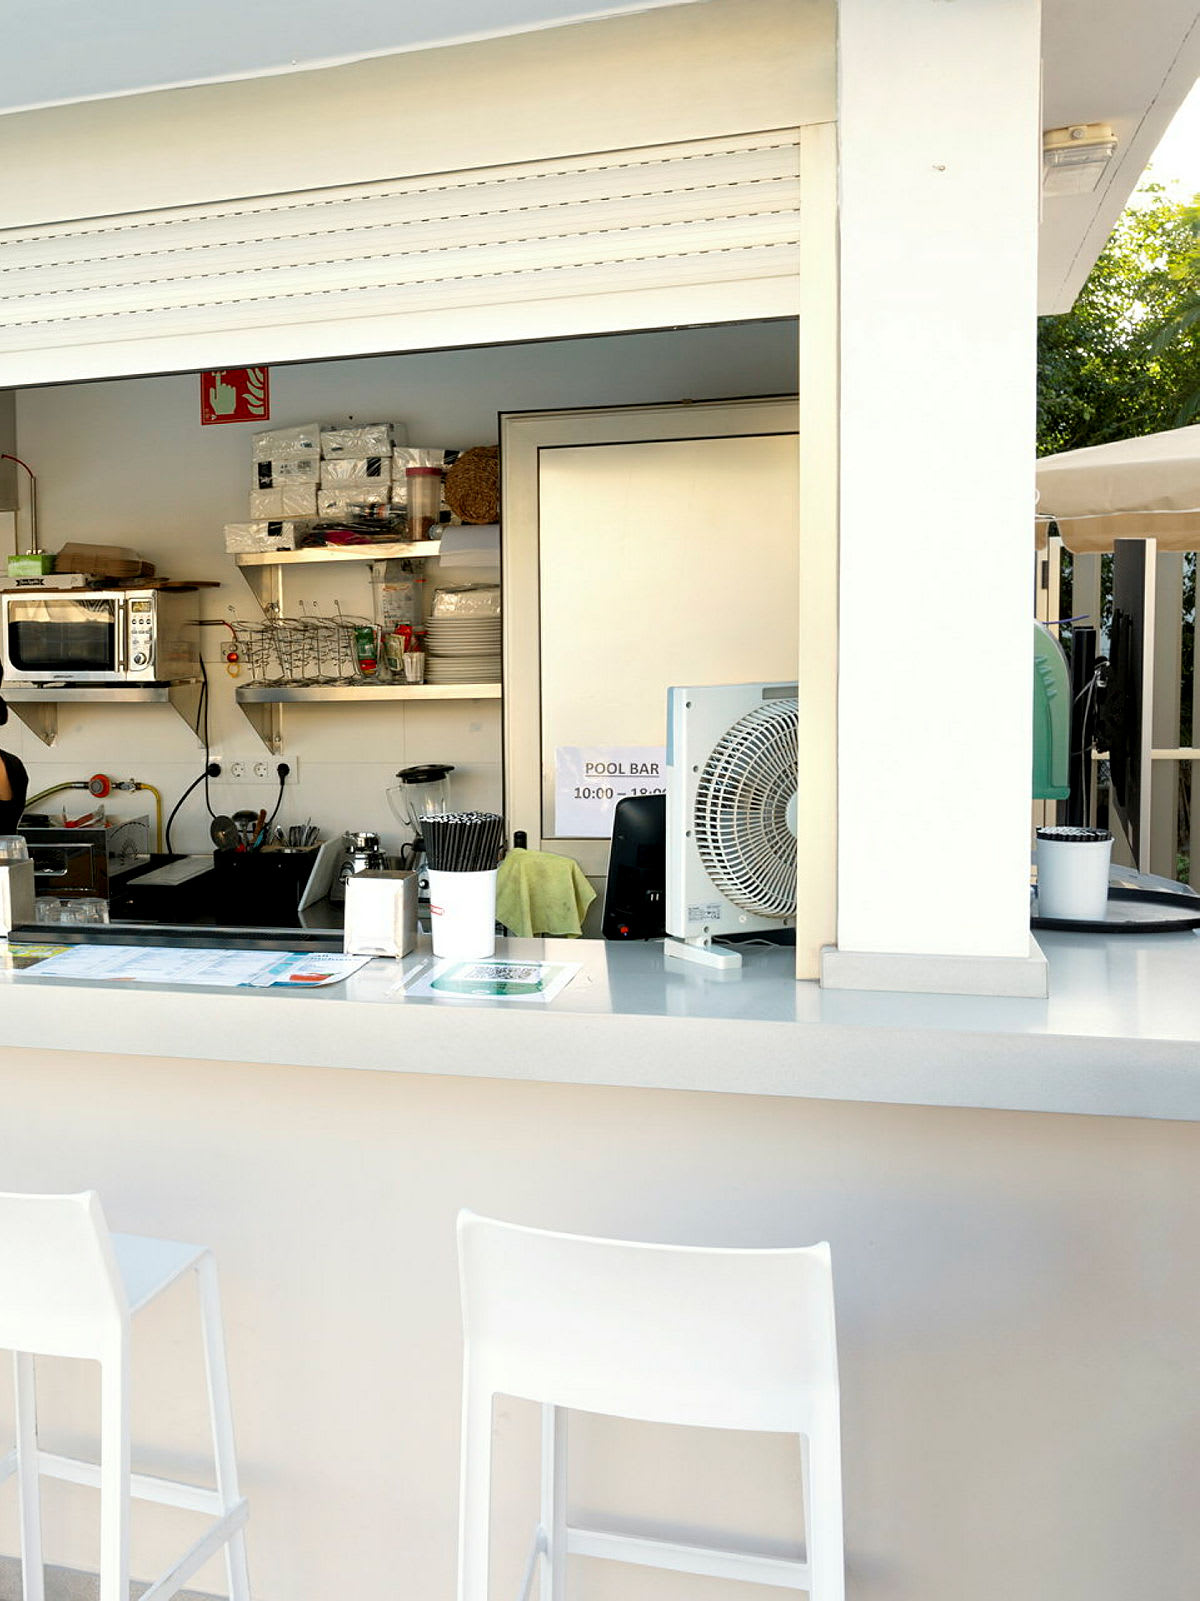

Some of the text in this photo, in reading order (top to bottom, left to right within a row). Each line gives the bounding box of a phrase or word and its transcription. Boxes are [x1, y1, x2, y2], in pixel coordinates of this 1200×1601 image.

[585, 762, 660, 775] POOL BAR
[574, 787, 614, 799] 10:00
